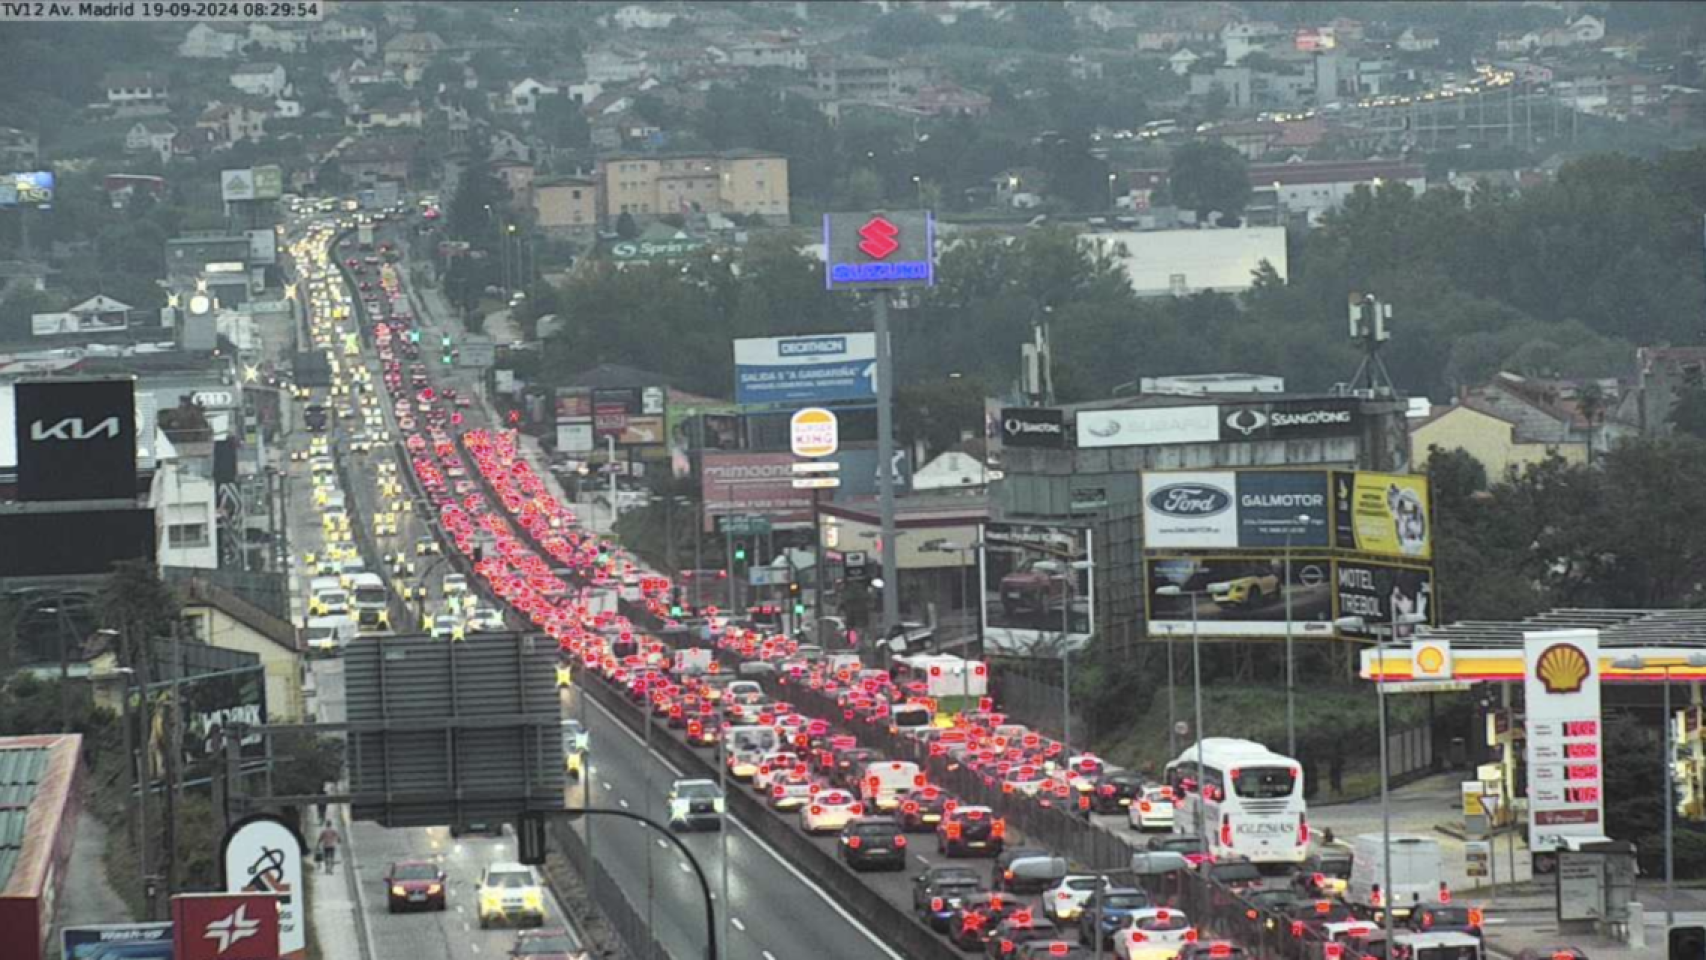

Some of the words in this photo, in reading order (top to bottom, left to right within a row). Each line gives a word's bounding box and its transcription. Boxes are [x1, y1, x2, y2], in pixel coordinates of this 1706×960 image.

[1163, 488, 1216, 512] Ford
[1241, 494, 1324, 508] GALMOTOR
[1338, 567, 1376, 591] MOTEL
[1338, 592, 1383, 617] TREBOL
[1236, 823, 1294, 834] IGLESIAS
